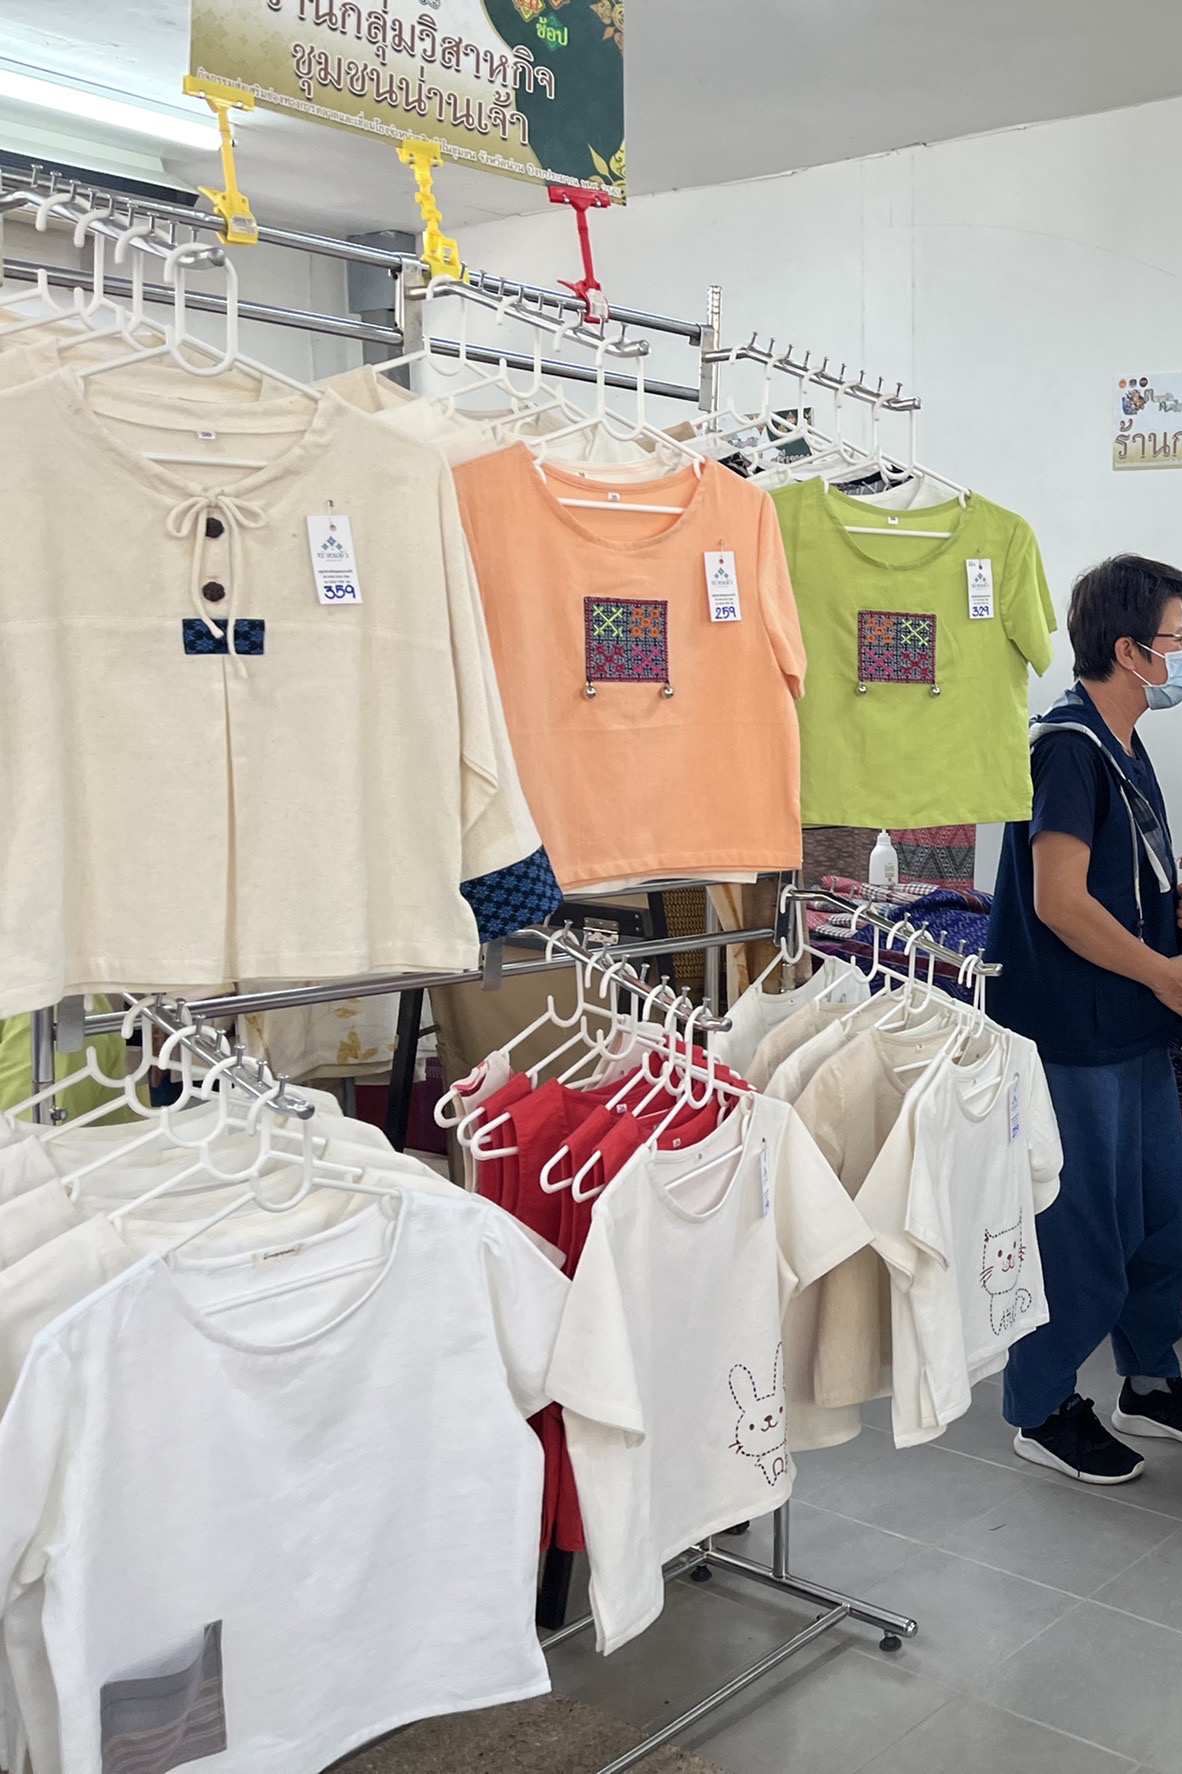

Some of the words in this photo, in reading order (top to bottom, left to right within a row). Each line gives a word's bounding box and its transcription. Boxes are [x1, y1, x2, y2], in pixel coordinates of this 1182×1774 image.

[536, 16, 568, 47] ช้อป
[292, 43, 528, 145] ชุมชนน่านเจ้า
[324, 584, 356, 600] 359
[715, 606, 737, 620] 259
[972, 605, 990, 617] 329
